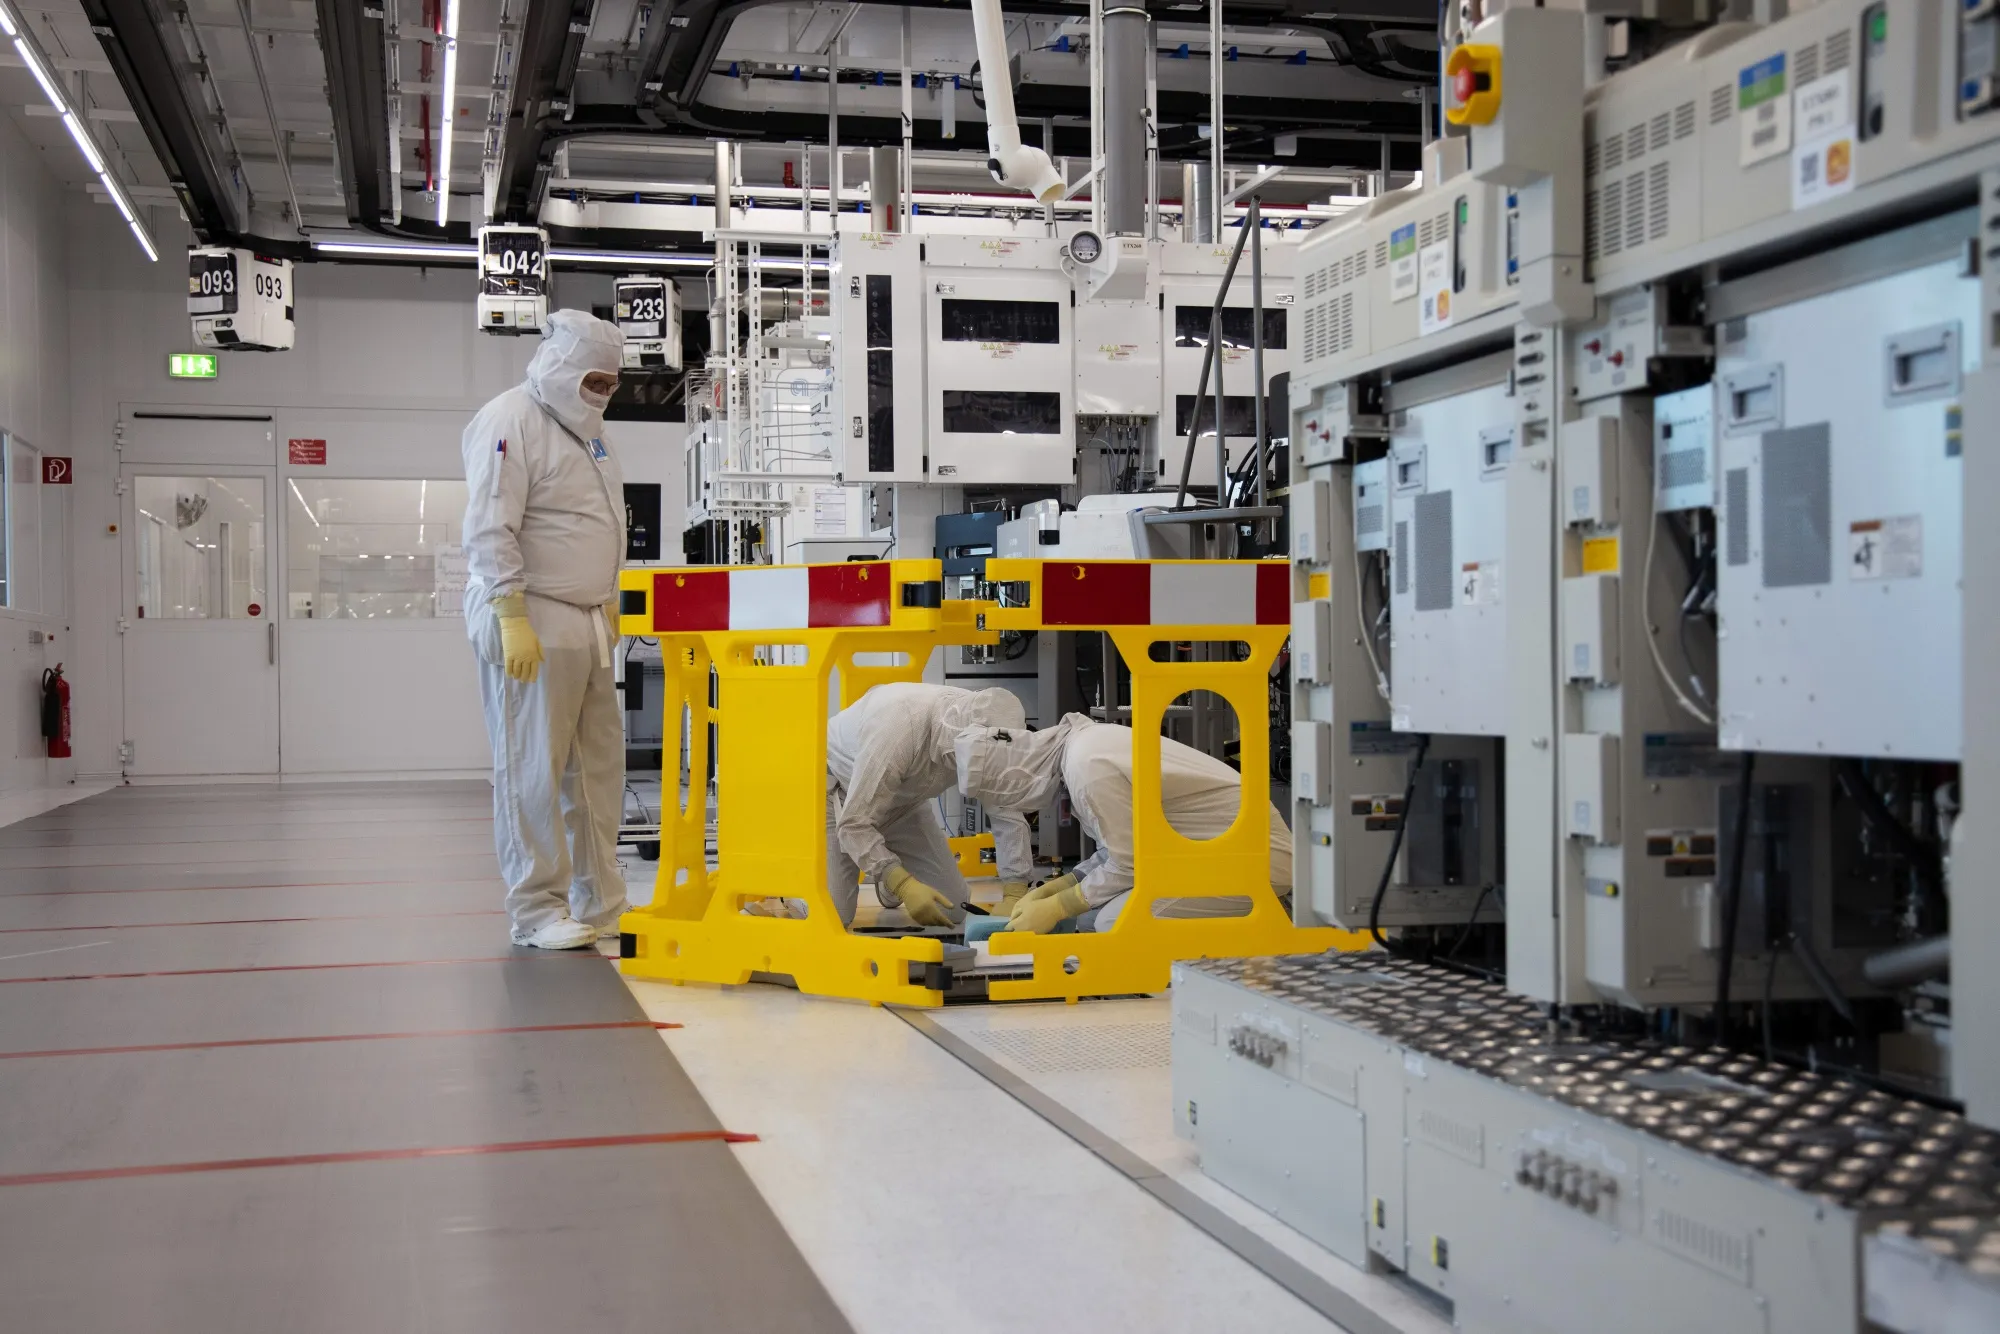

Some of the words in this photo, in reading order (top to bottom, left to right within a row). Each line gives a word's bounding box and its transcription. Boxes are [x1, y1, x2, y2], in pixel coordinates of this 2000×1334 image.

[503, 250, 541, 275] 042
[202, 270, 234, 294] 093
[256, 273, 282, 299] 093
[633, 298, 664, 320] 233
